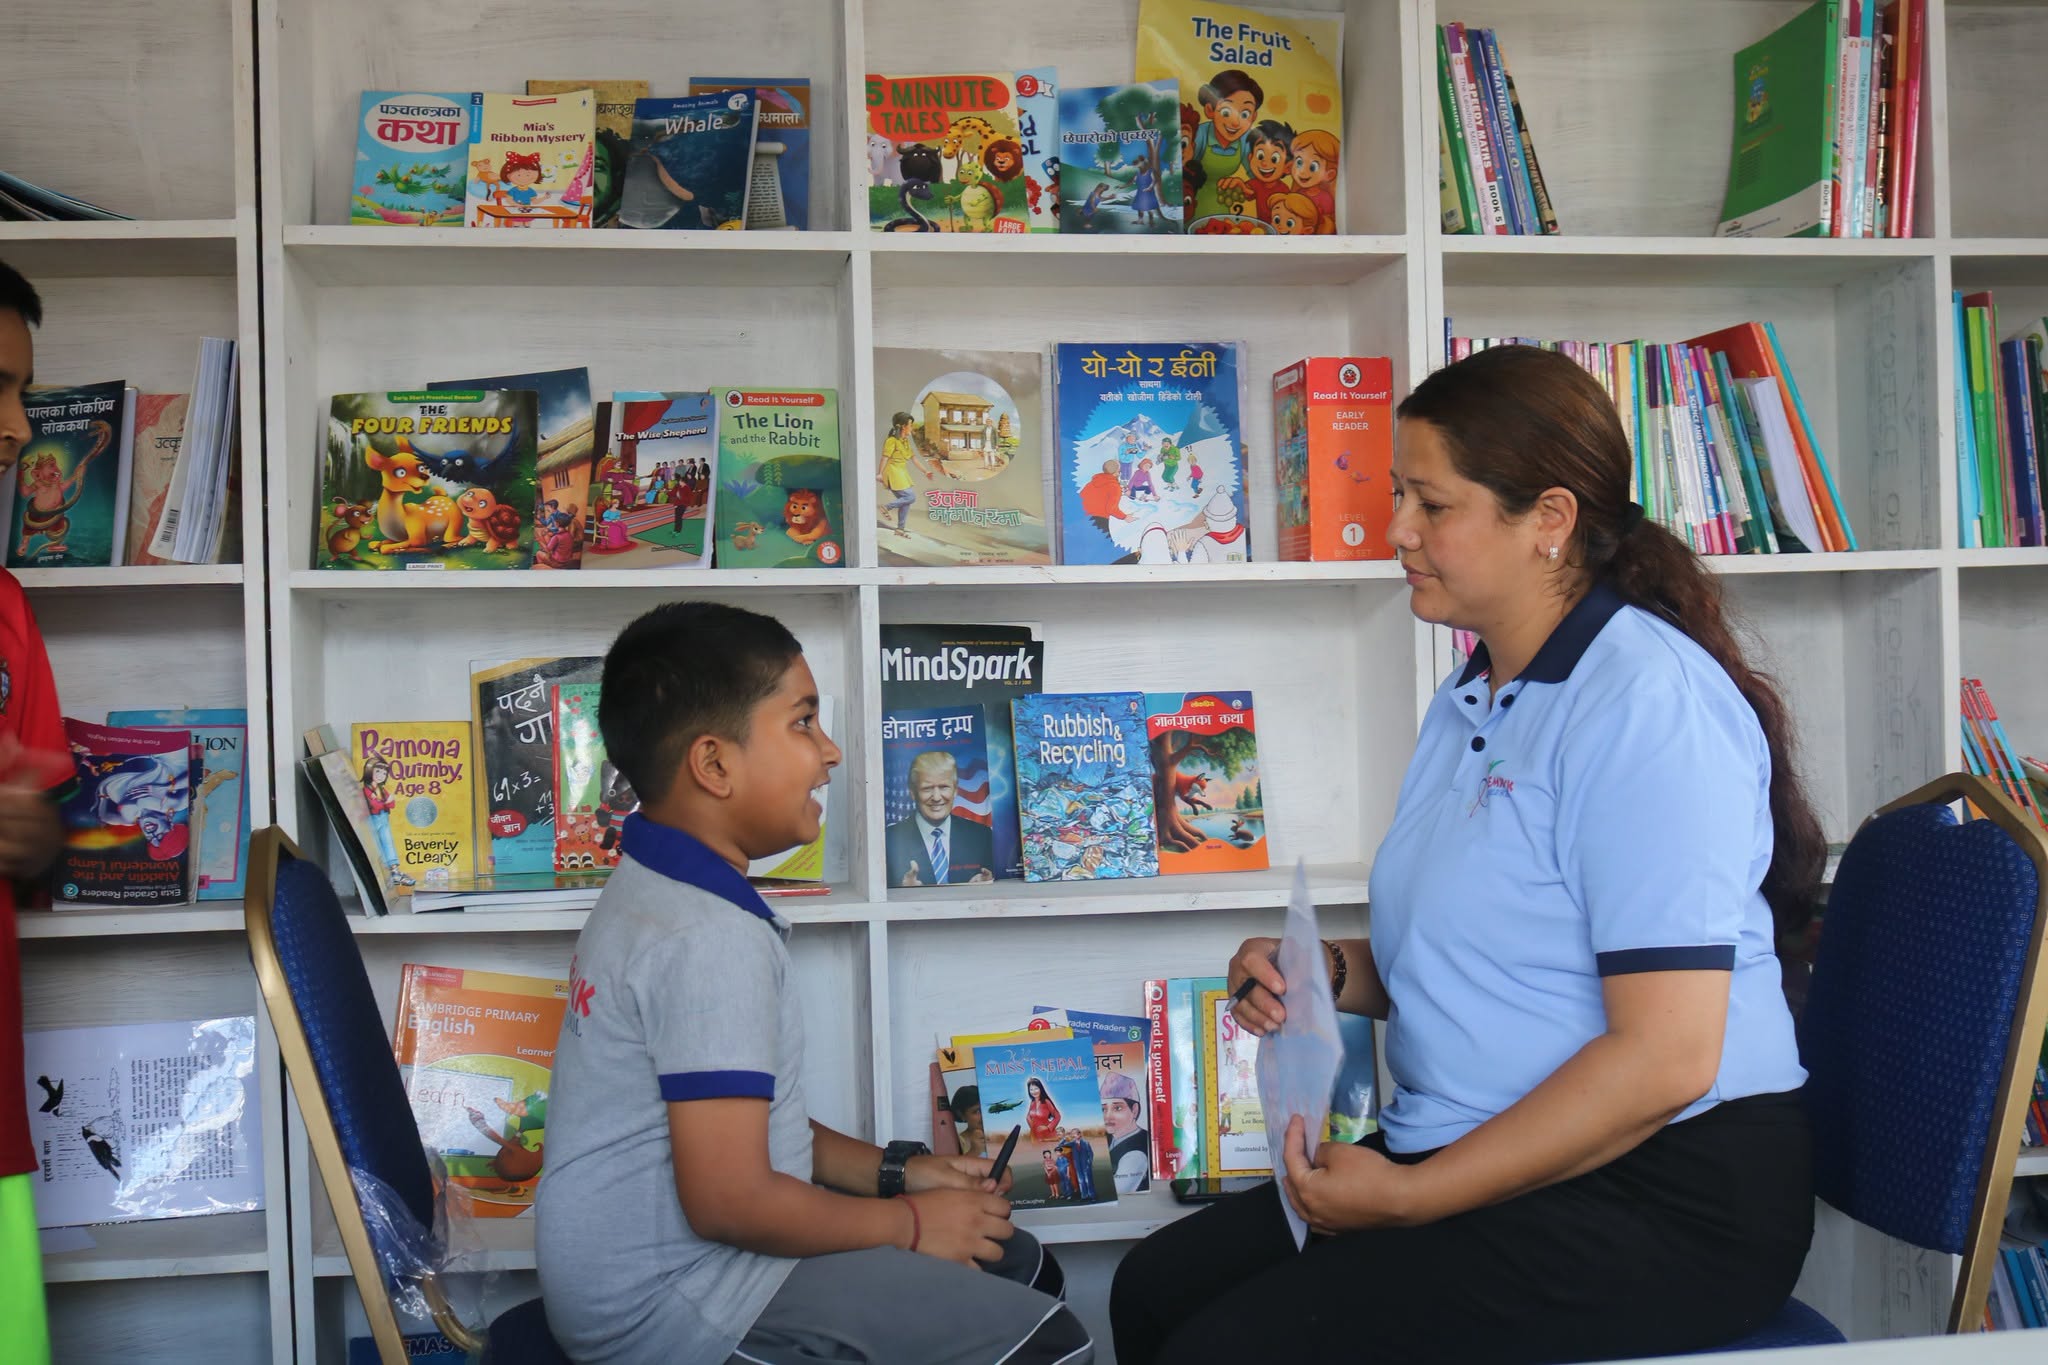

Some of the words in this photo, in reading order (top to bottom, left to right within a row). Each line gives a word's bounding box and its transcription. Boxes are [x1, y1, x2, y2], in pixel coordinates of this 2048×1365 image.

[1191, 17, 1232, 40] The
[1238, 23, 1292, 51] Fruit
[1209, 42, 1273, 67] Salad
[1024, 81, 1031, 91] 2
[866, 81, 885, 107] 5
[891, 80, 998, 109] MINUTE
[1490, 68, 1517, 154] MATHEMATICS
[523, 122, 555, 132] Mia's
[665, 112, 724, 136] Whale
[880, 112, 945, 135] TALES
[377, 118, 460, 146] कथा
[491, 133, 534, 143] Ribbon
[536, 132, 586, 145] Mystery
[1466, 82, 1484, 127] SPEEDY
[1477, 134, 1492, 168] MATHS
[1487, 184, 1500, 212] BOOK
[1148, 356, 1166, 378] र
[780, 396, 814, 404] Yourself
[1313, 391, 1338, 400] Read
[1349, 391, 1387, 400] Yourself
[24, 405, 66, 418] पालका
[420, 405, 448, 417] THE
[1336, 411, 1364, 419] EARLY
[1688, 394, 1699, 424] SCIENCE
[41, 419, 90, 435] लोककथा
[351, 418, 414, 435] FOUR
[418, 417, 513, 435] FRIENDS
[733, 414, 768, 430] The
[774, 413, 814, 431] Lion
[1332, 422, 1368, 431] READER
[615, 432, 636, 442] The
[637, 431, 661, 441] Wise
[662, 426, 708, 439] Shepherd
[730, 433, 748, 445] and
[750, 433, 766, 443] the
[769, 431, 821, 449] Rabbit
[1694, 424, 1702, 441] AND
[1696, 443, 1710, 489] TECHNOLOGY
[1339, 514, 1366, 522] LEVEL
[1350, 527, 1357, 542] 1
[1334, 550, 1353, 558] BOX
[1355, 549, 1372, 557] SET
[881, 647, 1035, 689] MindSpark
[1219, 713, 1244, 725] कथा
[883, 716, 937, 740] डोनाल्ड
[1043, 713, 1113, 739] Rubbish
[1113, 725, 1122, 742] &
[108, 736, 131, 744] Arabian
[359, 729, 461, 760] Ramona
[1040, 741, 1126, 768] Recycling
[388, 760, 463, 784] Quimby,
[394, 782, 426, 797] Age
[429, 782, 442, 795] 8
[489, 813, 512, 825] जीवन
[502, 821, 521, 833] ज्ञान
[67, 856, 105, 869] Lamp
[110, 861, 179, 871] Wonderful
[72, 871, 94, 881] the
[99, 872, 125, 881] and
[128, 871, 179, 882] Aladdin
[81, 889, 121, 899] Readers
[123, 890, 158, 898] Graded
[160, 888, 181, 897] Ekta
[410, 1001, 482, 1018] CAMBRIDGE
[484, 1010, 540, 1023] PRIMARY
[407, 1014, 476, 1036] English
[1067, 1020, 1091, 1029] raded
[1092, 1021, 1126, 1032] Readers
[1151, 1004, 1163, 1037] Read
[1152, 1041, 1164, 1050] it
[985, 1060, 1025, 1076] MISS
[1152, 1051, 1167, 1104] yourself
[1170, 1160, 1177, 1172] 1
